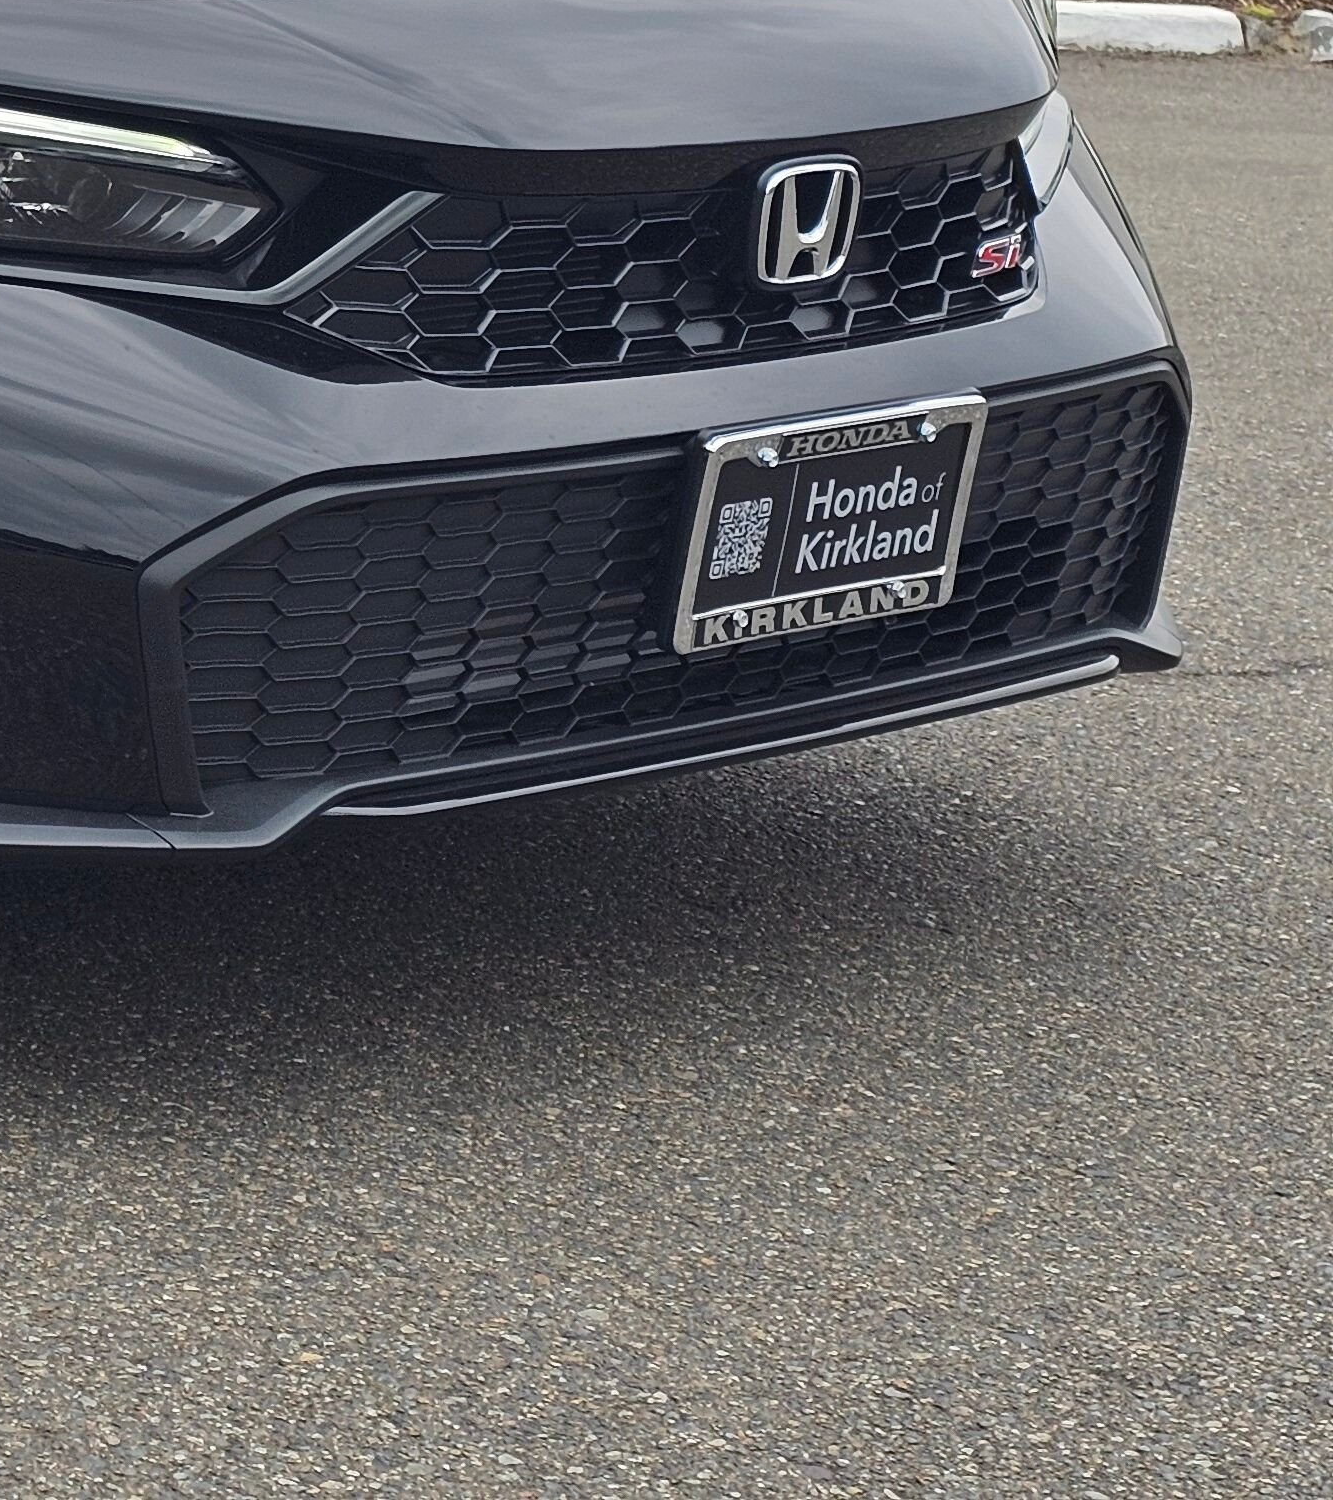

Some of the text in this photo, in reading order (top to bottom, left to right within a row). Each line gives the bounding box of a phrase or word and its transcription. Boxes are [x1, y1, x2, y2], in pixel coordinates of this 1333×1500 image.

[971, 234, 1022, 278] Si
[786, 420, 912, 457] HONDA
[805, 465, 946, 523] Honda of
[794, 508, 940, 574] Kirkland
